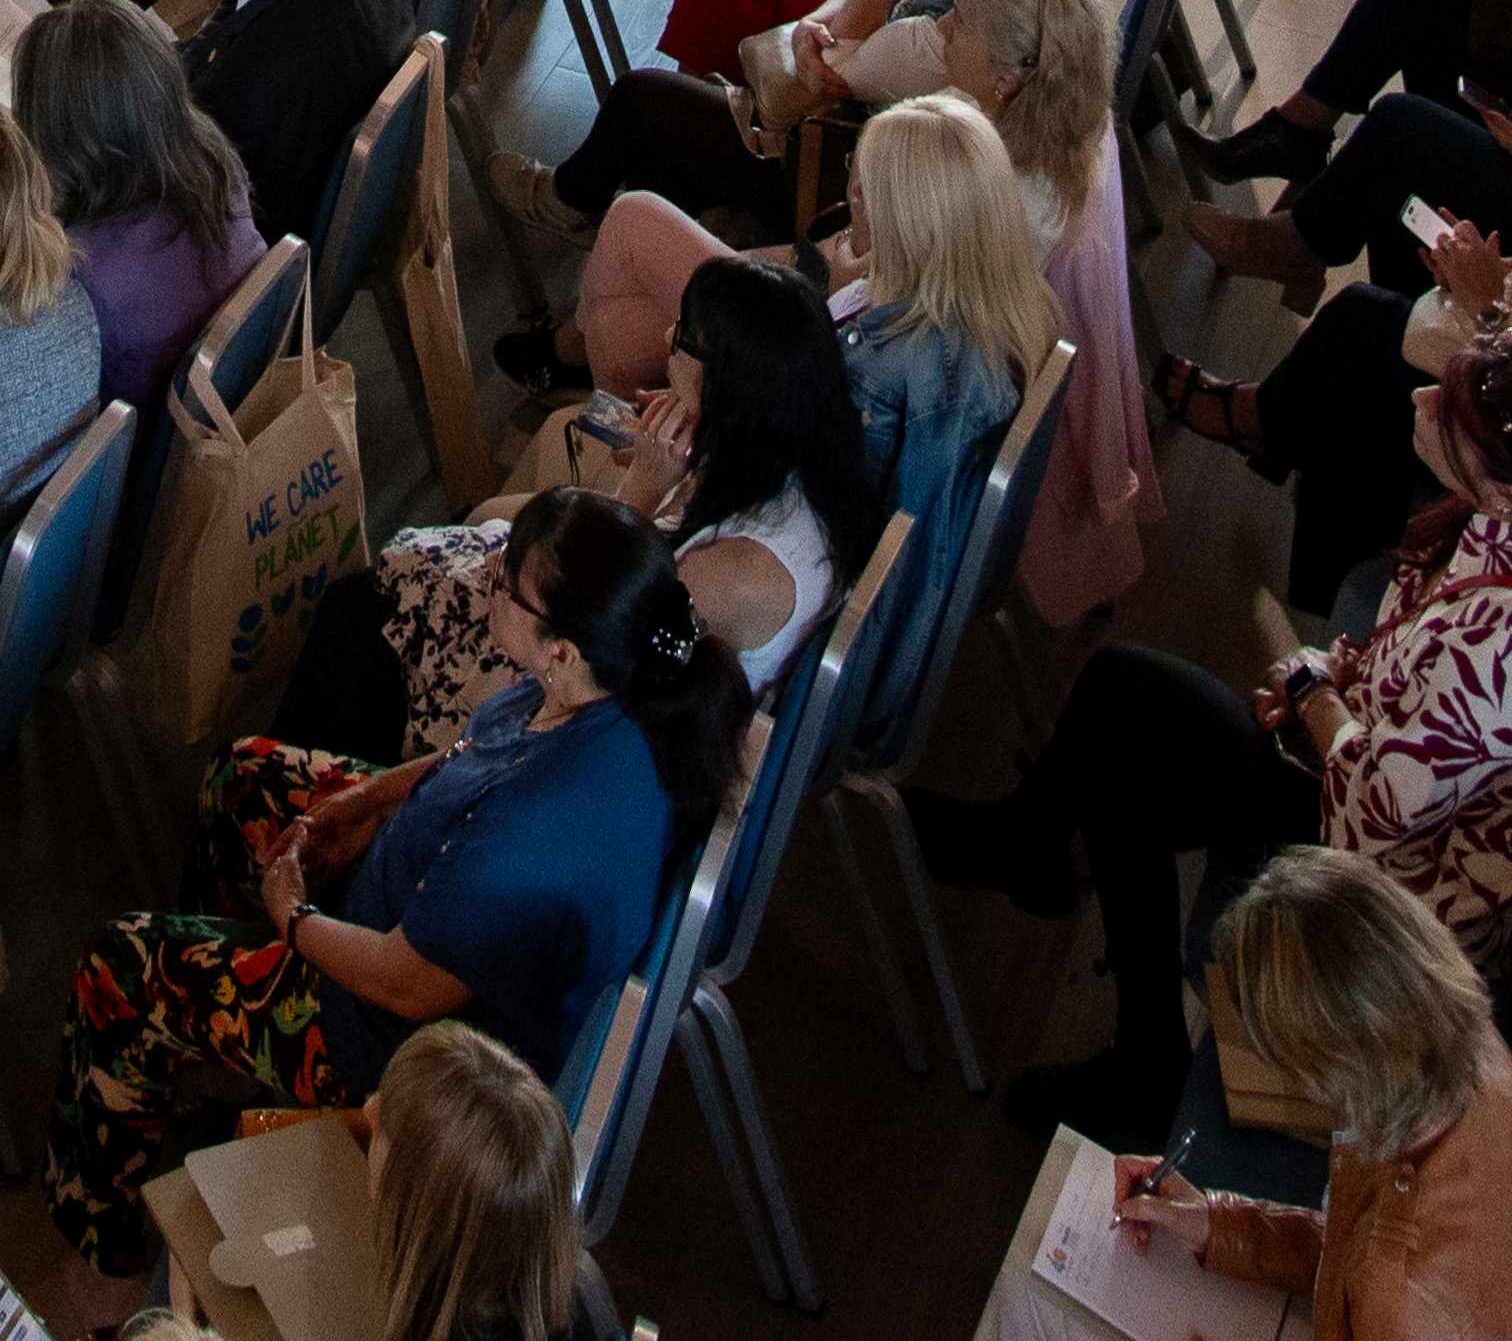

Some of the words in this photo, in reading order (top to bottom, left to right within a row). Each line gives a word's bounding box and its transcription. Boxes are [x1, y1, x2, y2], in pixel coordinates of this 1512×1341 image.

[245, 495, 280, 546] WE
[287, 448, 344, 517] CARE
[255, 501, 338, 591] PLANET
